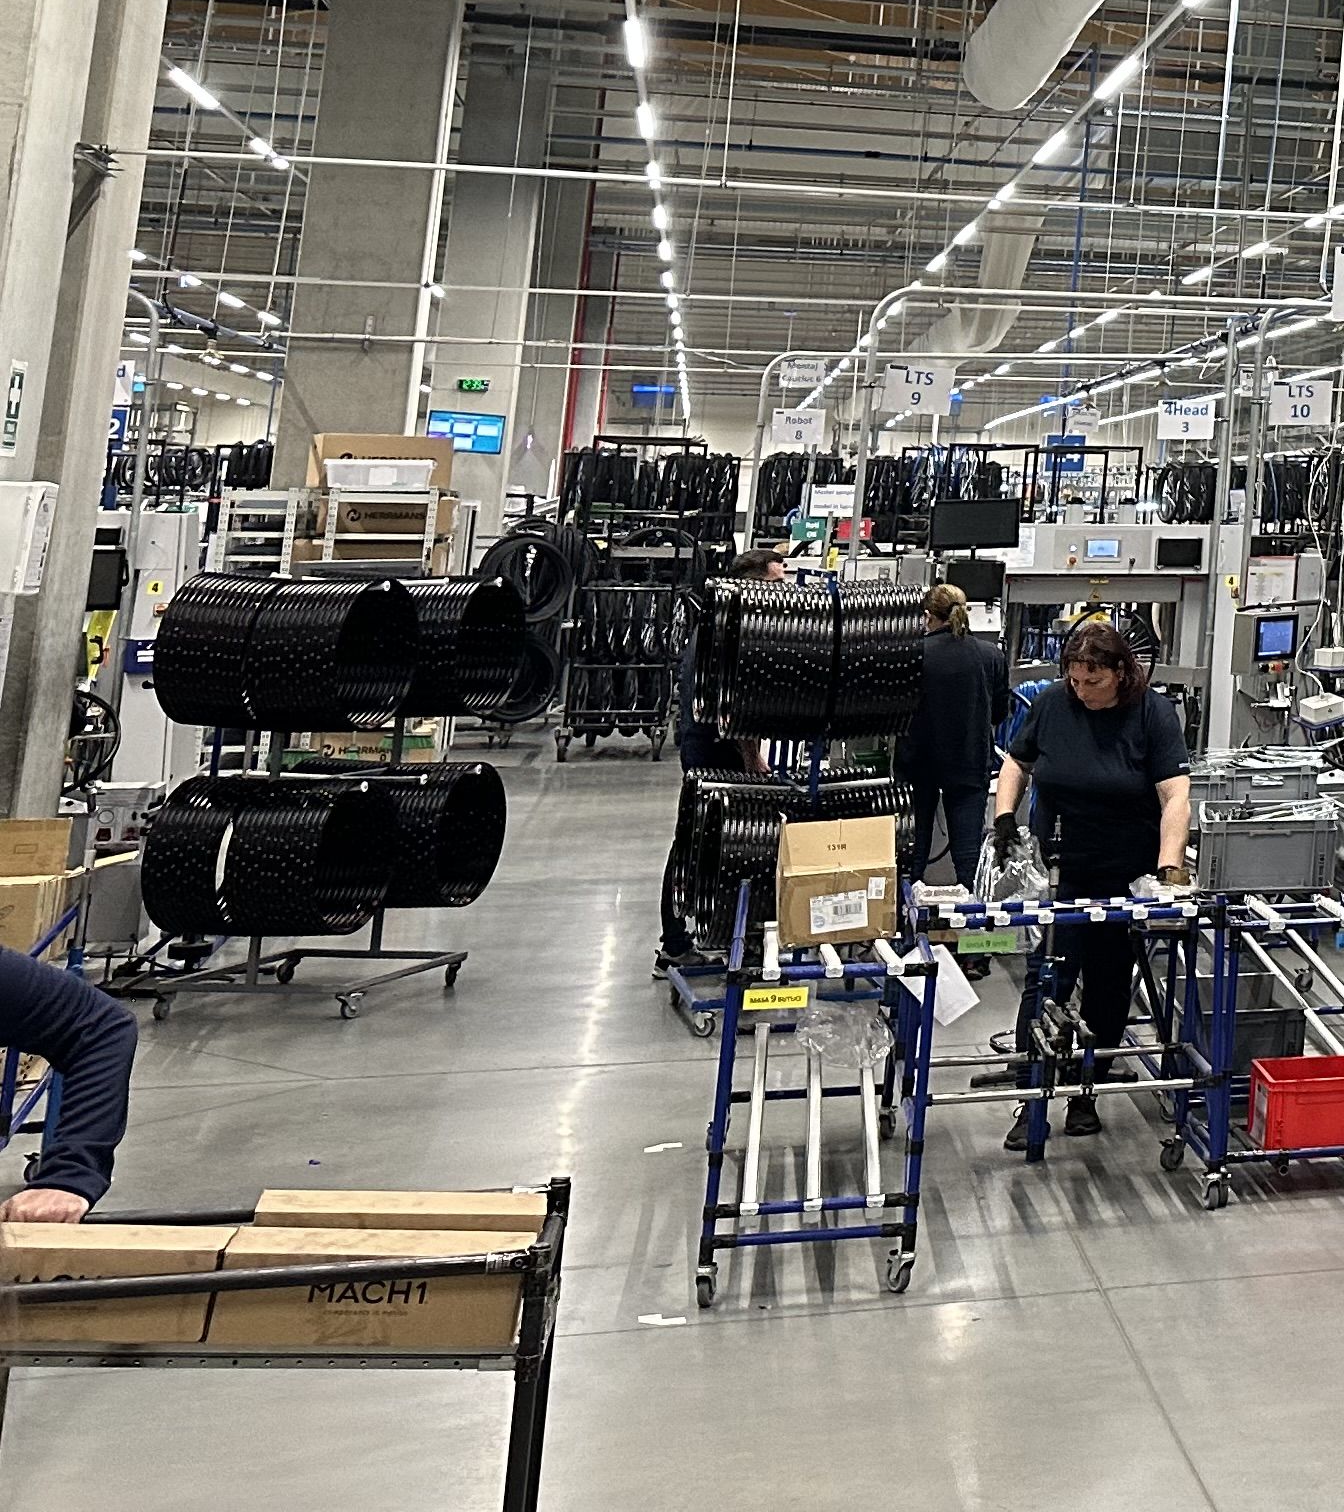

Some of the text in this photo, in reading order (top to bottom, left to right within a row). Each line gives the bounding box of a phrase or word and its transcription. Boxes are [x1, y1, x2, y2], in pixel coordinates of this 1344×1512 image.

[904, 370, 934, 386] LTS
[1288, 384, 1314, 398] LTS
[911, 392, 921, 405] 9
[1164, 403, 1209, 416] 4Head
[1291, 404, 1310, 418] 10
[1182, 422, 1189, 433] 3
[151, 582, 159, 592] 4
[1228, 576, 1234, 585] 4
[771, 995, 777, 1003] 9
[308, 1281, 428, 1305] MACH1
